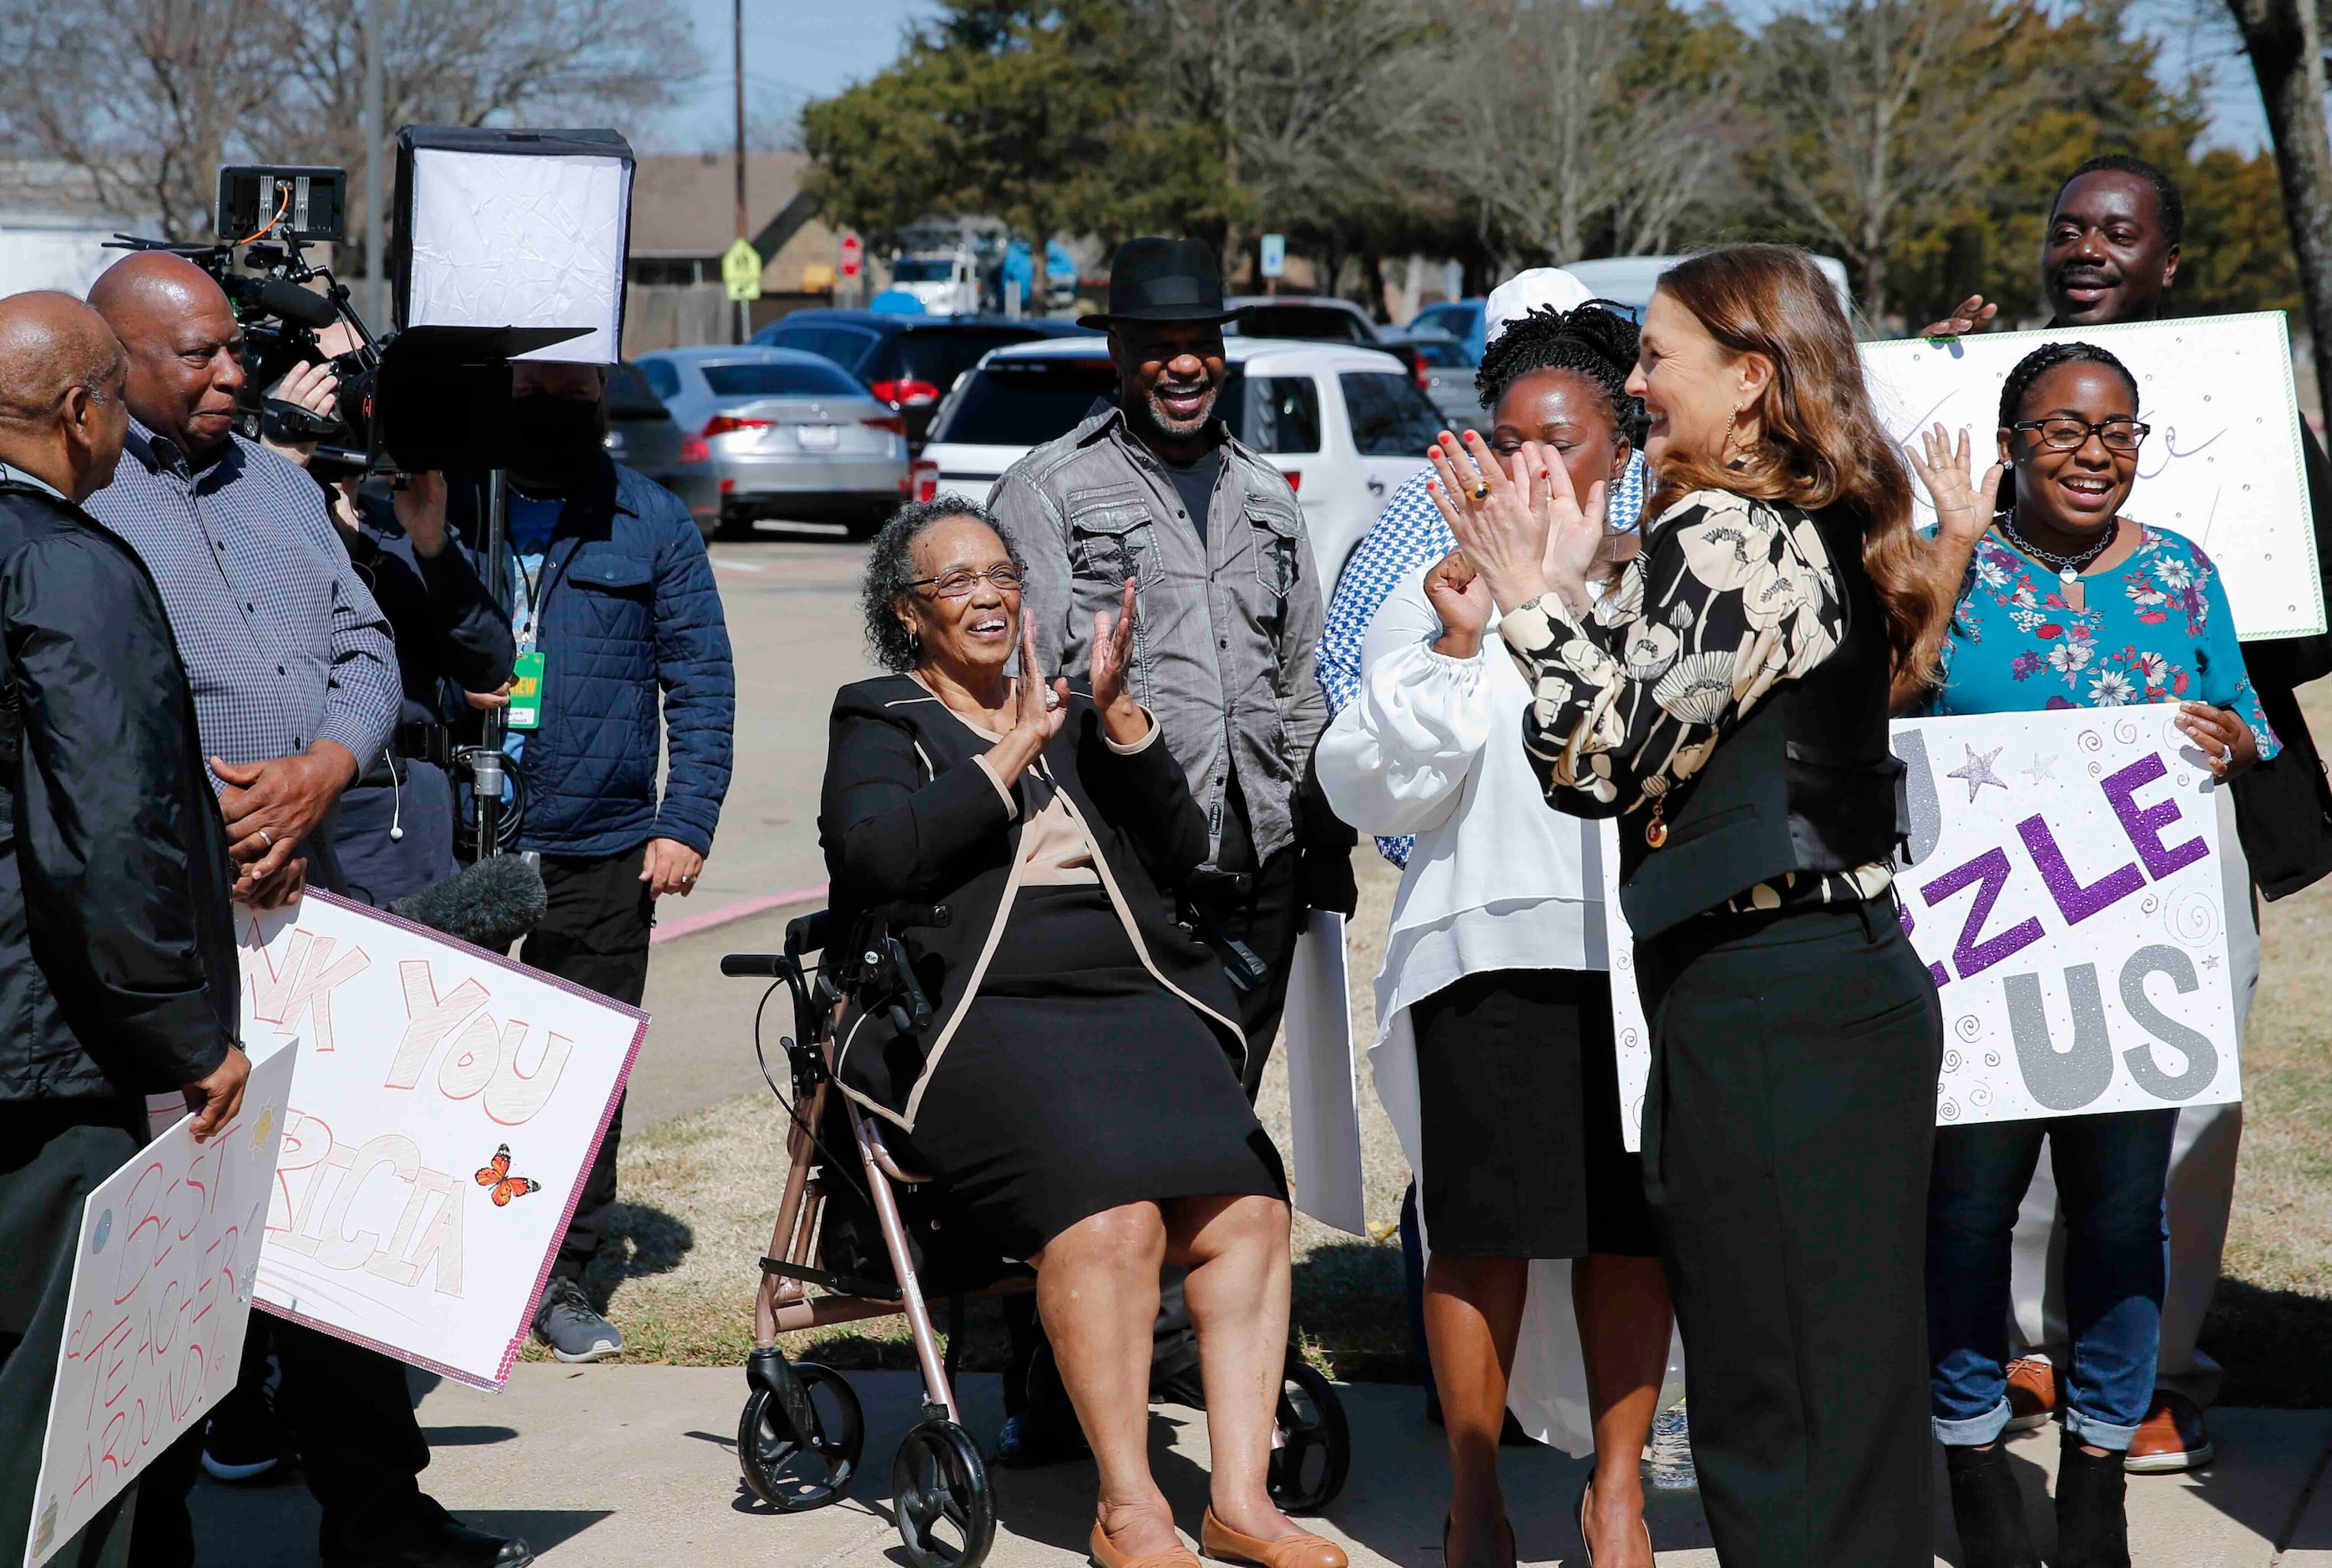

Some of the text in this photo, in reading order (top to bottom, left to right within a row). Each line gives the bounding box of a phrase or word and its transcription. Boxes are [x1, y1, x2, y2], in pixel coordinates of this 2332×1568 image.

[1897, 752, 2210, 989] ZLE
[237, 916, 574, 1126] NK YOU
[2004, 944, 2218, 1111] US
[114, 1123, 242, 1306] BEST
[266, 1107, 466, 1300] RICIA
[63, 1315, 220, 1520] AROUND!
[83, 1226, 238, 1431] TEACHER
